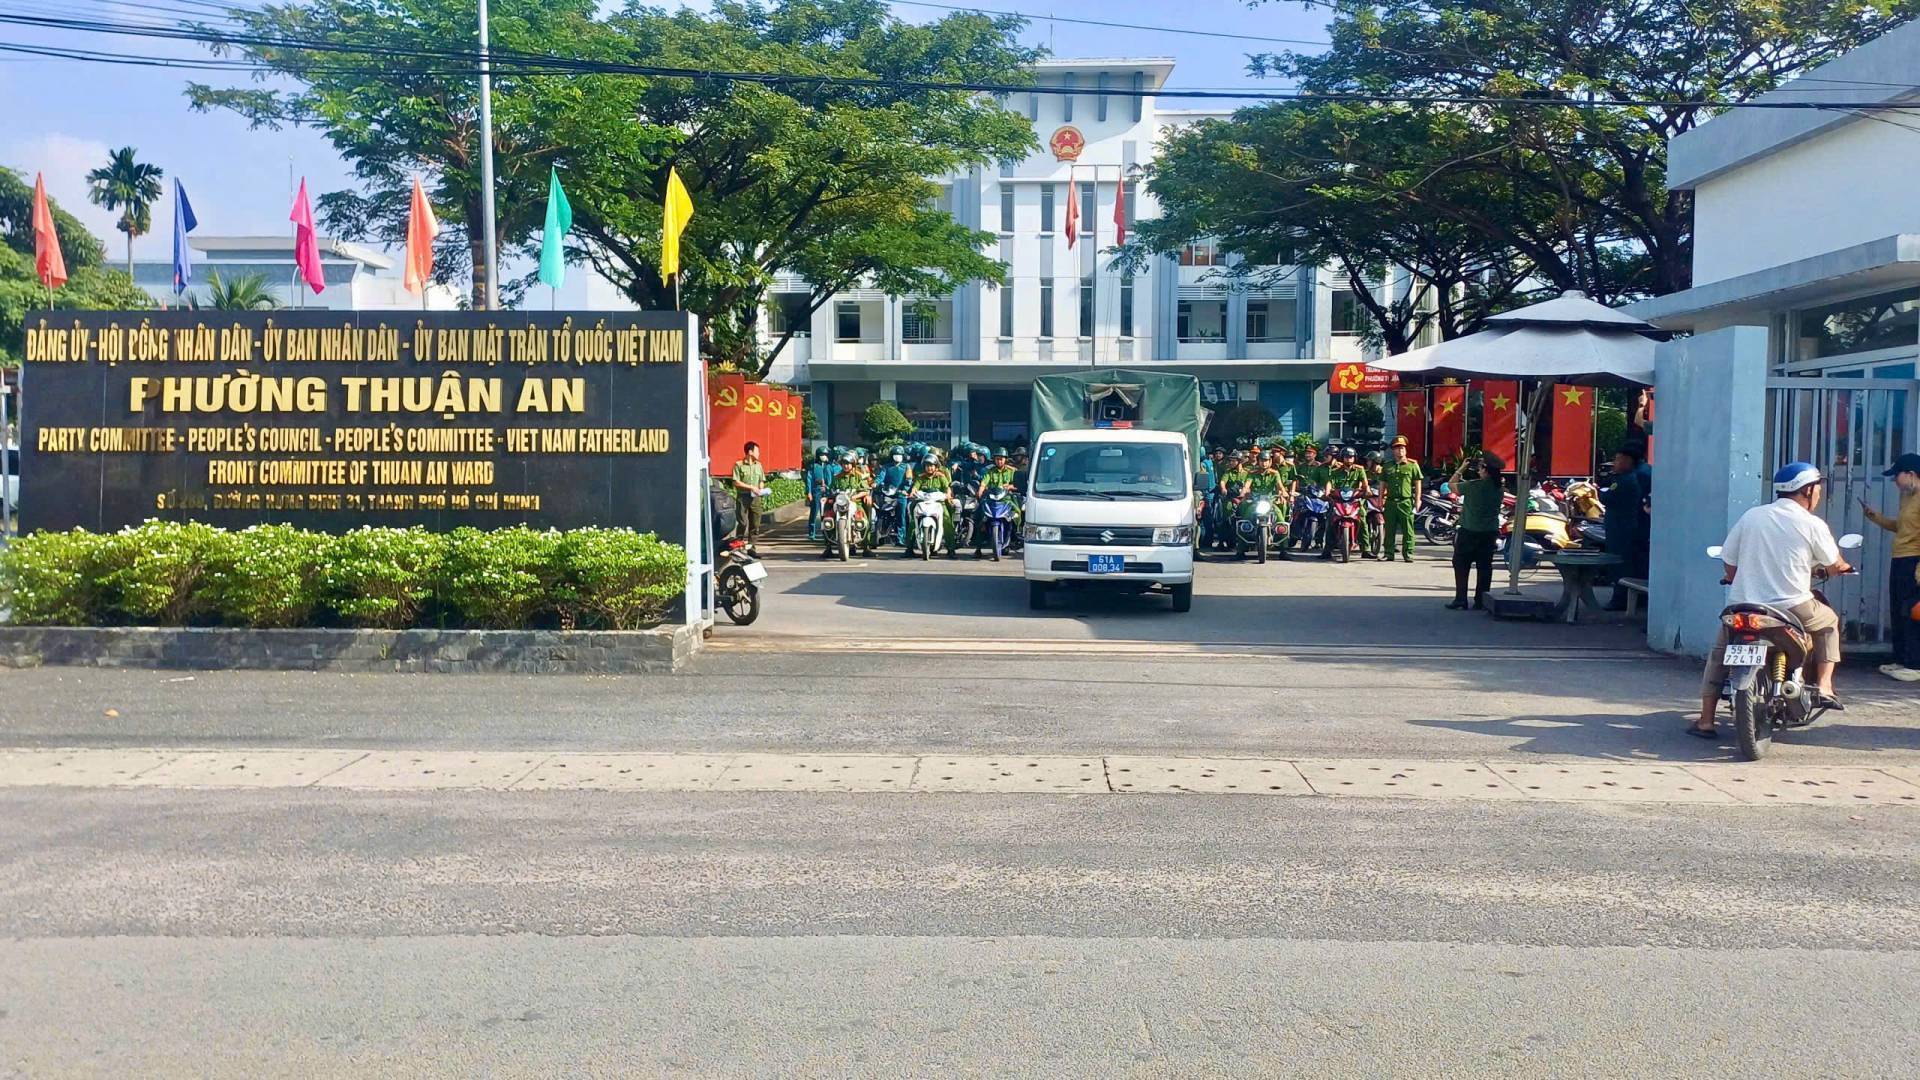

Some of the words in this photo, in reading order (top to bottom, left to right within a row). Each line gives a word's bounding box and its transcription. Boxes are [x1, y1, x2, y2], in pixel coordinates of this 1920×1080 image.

[27, 318, 67, 361] ĐẢNG
[70, 319, 89, 361] ỦY
[98, 322, 123, 366] HỘI
[128, 318, 169, 361] ĐỒNG
[174, 322, 216, 361] NHÂN
[220, 322, 252, 361] DÂN
[263, 318, 283, 361] ỦY
[286, 329, 317, 361] BAN
[320, 322, 364, 361] NHÂN
[367, 322, 399, 361] DÂN
[414, 319, 433, 362] ỦY
[437, 329, 469, 361] BAN
[473, 323, 504, 366] MẶT
[508, 323, 548, 366] TRẬN
[552, 316, 573, 362] TỔ
[575, 318, 613, 366] QUỐC
[616, 323, 646, 366] VIỆT
[650, 330, 683, 362] NAM
[130, 368, 327, 412] PHƯỜNG
[341, 370, 501, 420] THUẬN
[516, 377, 585, 413] AN
[38, 427, 85, 451] PARTY
[89, 427, 176, 451] COMMITTEE
[188, 422, 256, 452] PEOPLE'S
[259, 427, 322, 452] COUNCIL
[335, 422, 404, 452] PEOPLE'S
[406, 427, 494, 452] COMMITTEE
[506, 428, 538, 452] VIET
[541, 428, 576, 452] NAM
[579, 428, 669, 452] FATHERLAND
[208, 460, 255, 484] FRONT
[259, 460, 346, 485] COMMITTEE
[350, 461, 368, 485] OF
[372, 461, 422, 485] THUAN
[426, 461, 448, 485] AN
[451, 461, 494, 485] WARD
[503, 494, 540, 511] MINH
